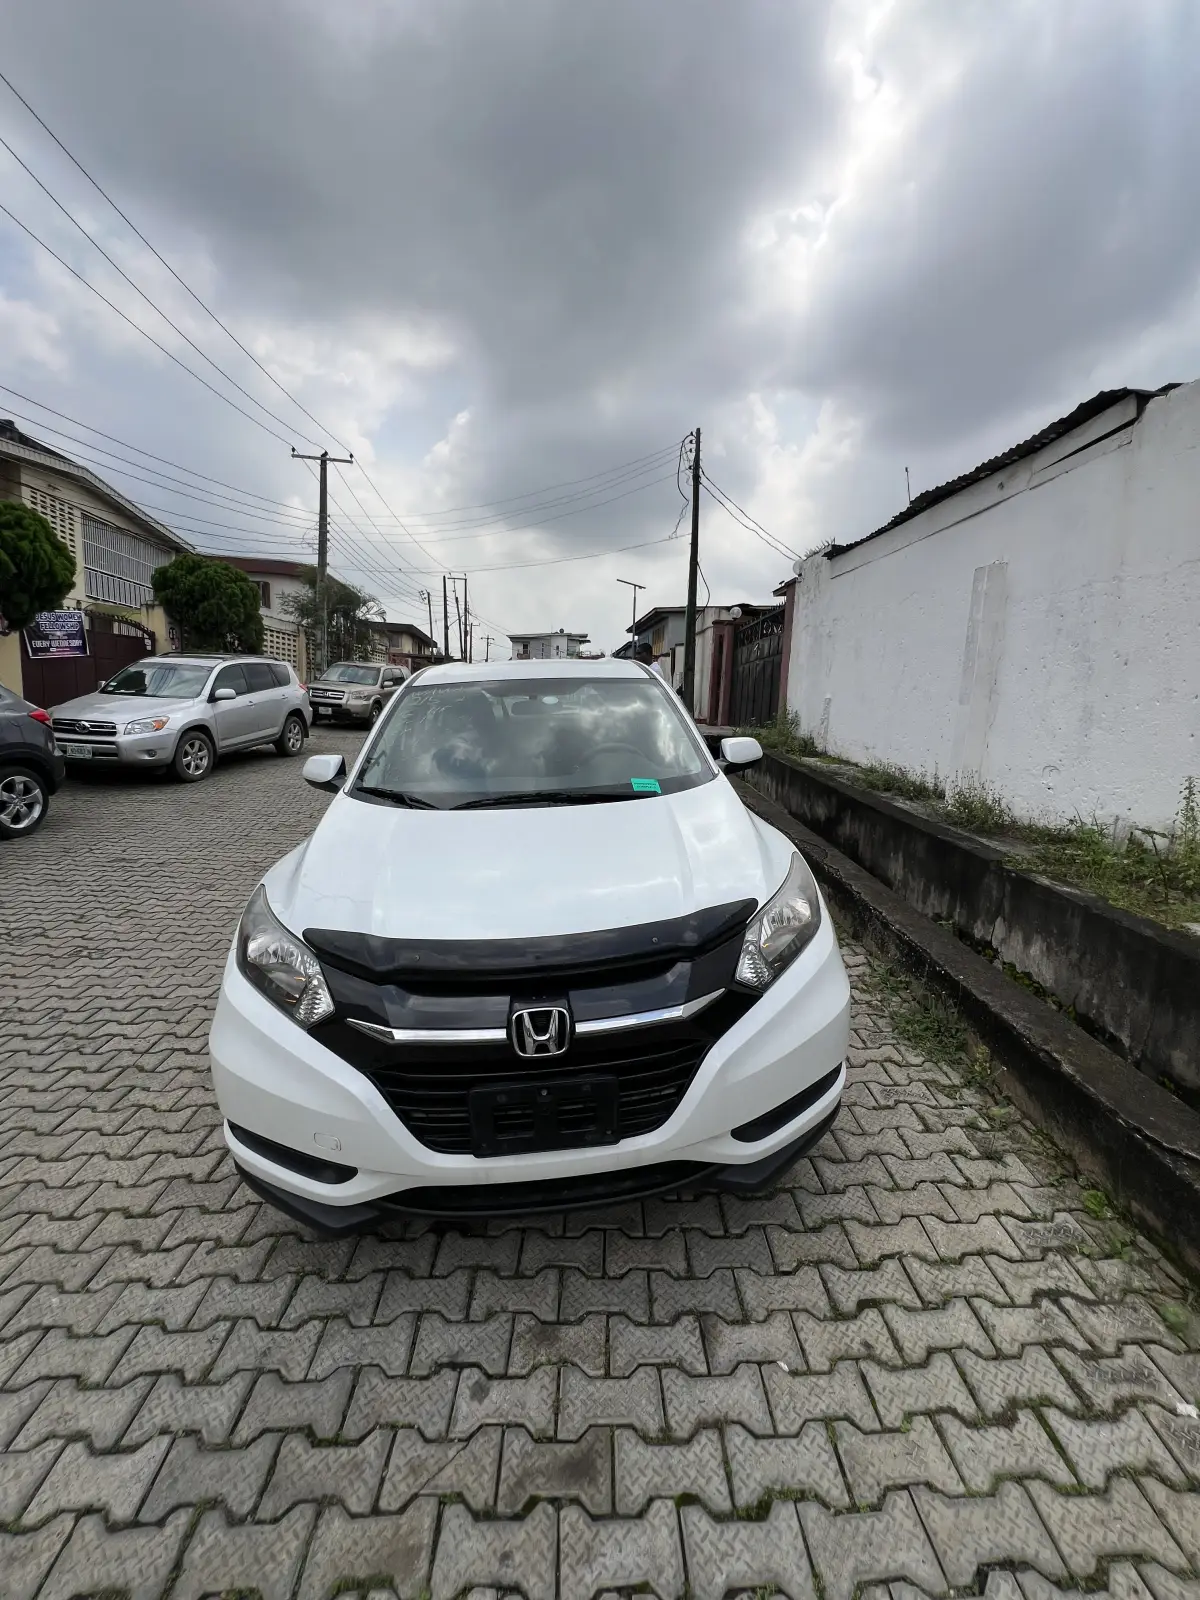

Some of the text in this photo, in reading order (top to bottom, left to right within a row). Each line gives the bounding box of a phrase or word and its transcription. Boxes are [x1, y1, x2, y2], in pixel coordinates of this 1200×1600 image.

[35, 612, 82, 621] JESUS WOMEN
[39, 622, 80, 630] FELLOWSHIP
